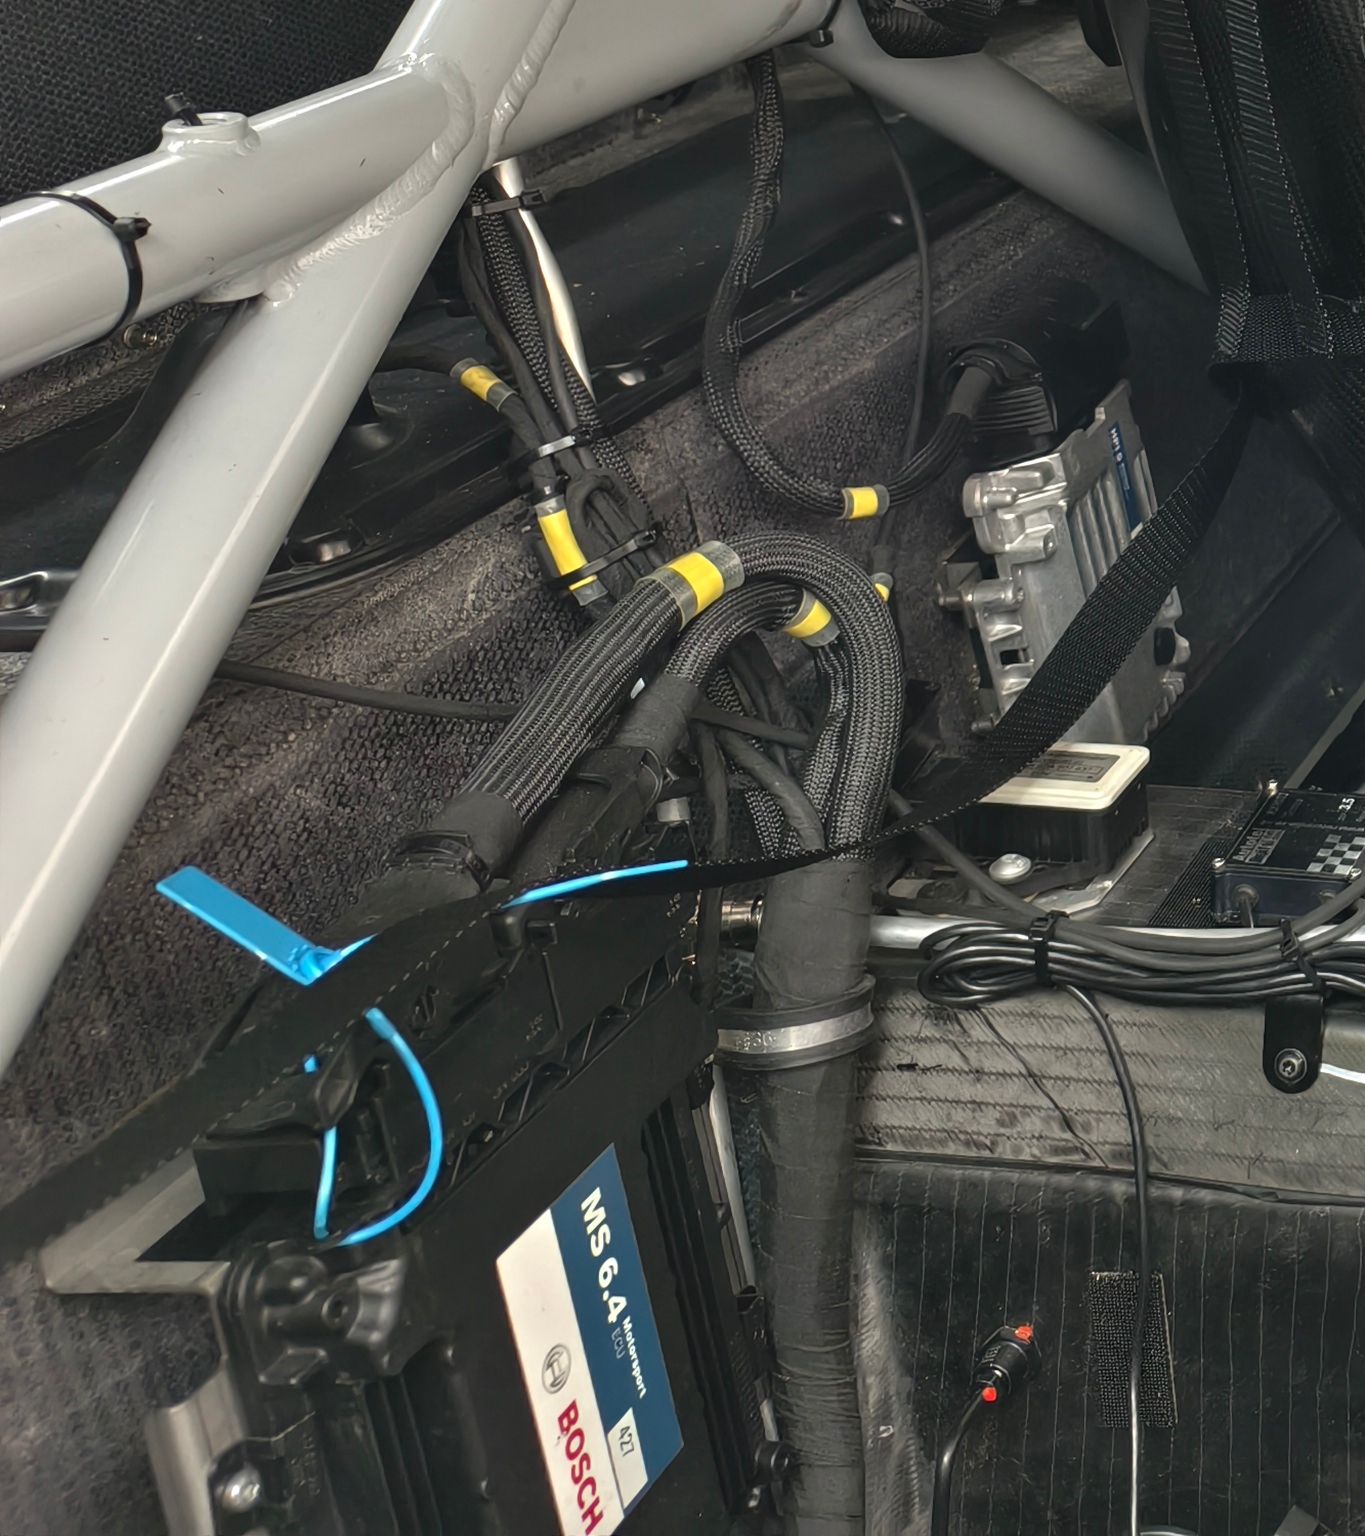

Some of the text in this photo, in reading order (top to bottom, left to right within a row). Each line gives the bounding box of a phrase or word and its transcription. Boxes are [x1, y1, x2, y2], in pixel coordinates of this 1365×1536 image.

[581, 1187, 628, 1324] MS 6.4
[611, 1327, 625, 1360] ECU
[622, 1315, 648, 1399] Motorsport
[557, 1399, 604, 1536] BOSCH
[617, 1425, 636, 1457] 427
